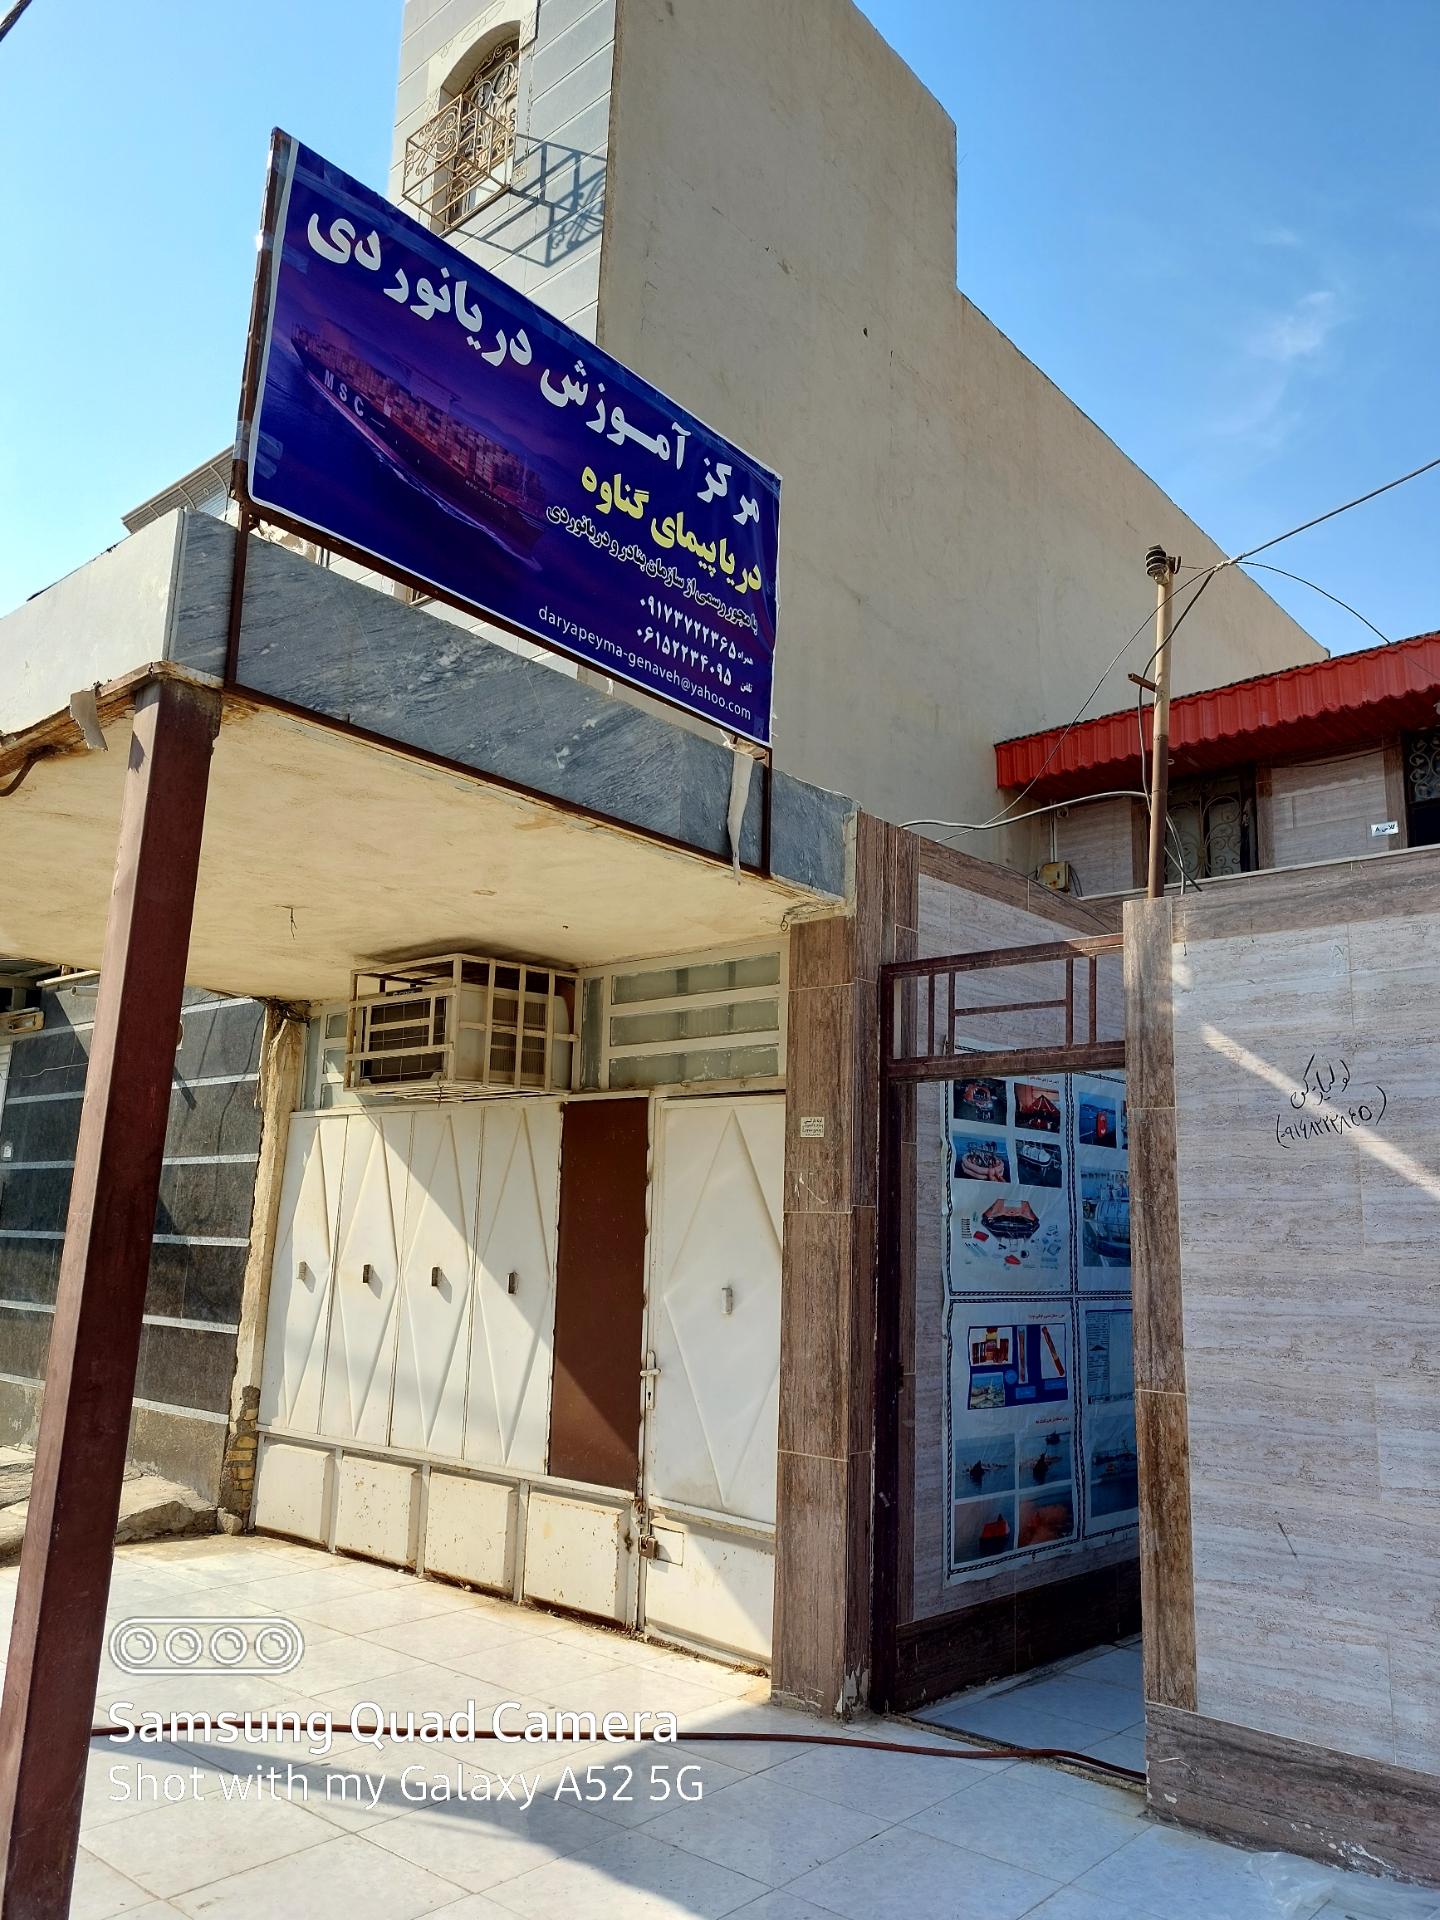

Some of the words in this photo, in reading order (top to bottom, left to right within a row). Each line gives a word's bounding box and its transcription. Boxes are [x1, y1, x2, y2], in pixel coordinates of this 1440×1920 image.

[307, 213, 532, 367] دریانوردی
[323, 369, 364, 417] MSC
[540, 360, 692, 470] آموزش
[581, 466, 650, 519] گناوه
[697, 458, 760, 525] مرکز
[546, 506, 611, 548] دریانوردی
[609, 540, 619, 556] و
[618, 545, 647, 571] بنادر
[645, 558, 684, 587] سازمان
[683, 577, 696, 598] از
[538, 605, 751, 720] daryapeyma-genaveh@yahoo.com
[737, 651, 754, 665] همراه
[740, 683, 753, 693] تلفن
